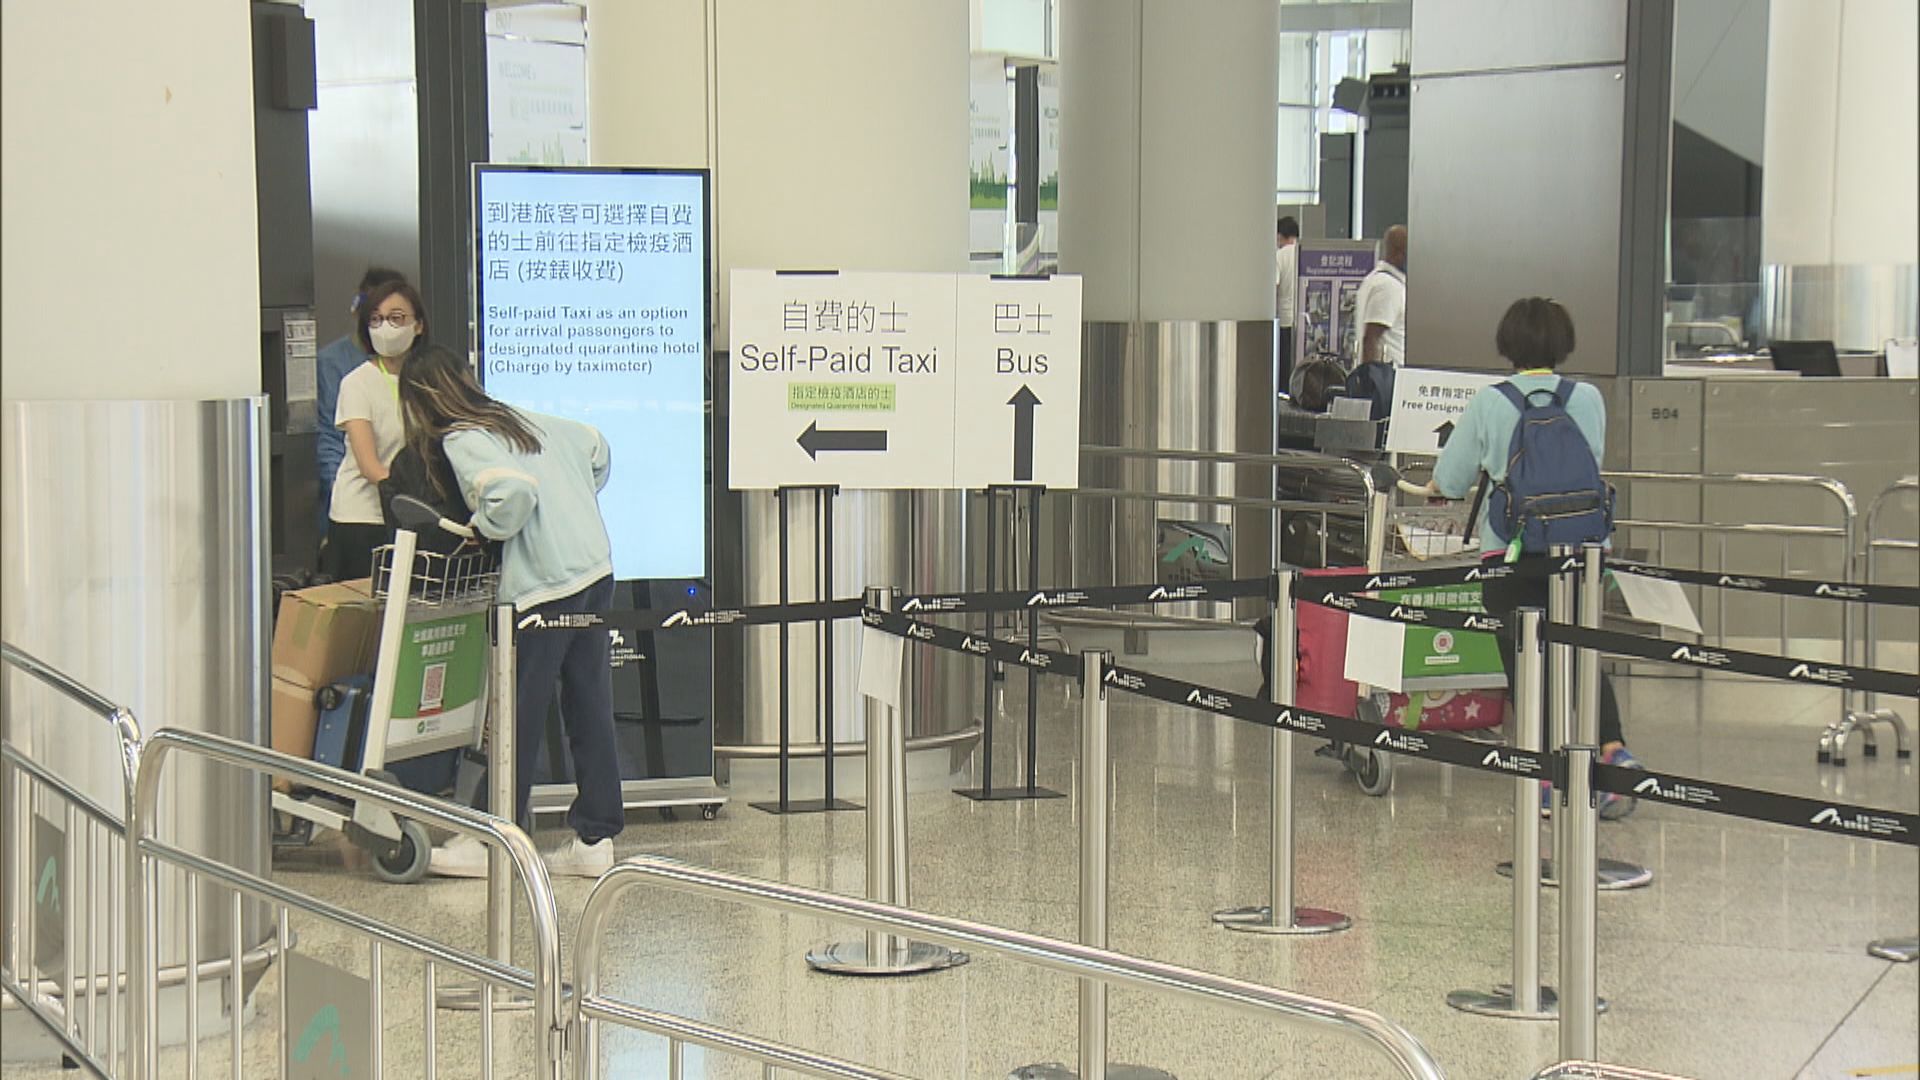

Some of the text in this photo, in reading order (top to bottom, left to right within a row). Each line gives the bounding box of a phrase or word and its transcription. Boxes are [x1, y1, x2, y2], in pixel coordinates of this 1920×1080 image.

[487, 202, 692, 226] 到港旅客可選擇自費
[487, 230, 693, 253] 的士前往指定檢疫酒
[488, 259, 625, 283] 店 (按錶收費)
[488, 305, 688, 322] Self-paid Taxi as an option
[782, 299, 909, 334] 自費的士
[993, 303, 1053, 336] 巴士
[488, 324, 674, 341] for arrival passengers to
[488, 342, 700, 358] designated quarantine hotel
[739, 344, 938, 374] Self-Paid Taxi
[996, 347, 1049, 375] Bus
[488, 359, 653, 376] (Charge by taximeter)
[1401, 400, 1465, 414] Free Designa
